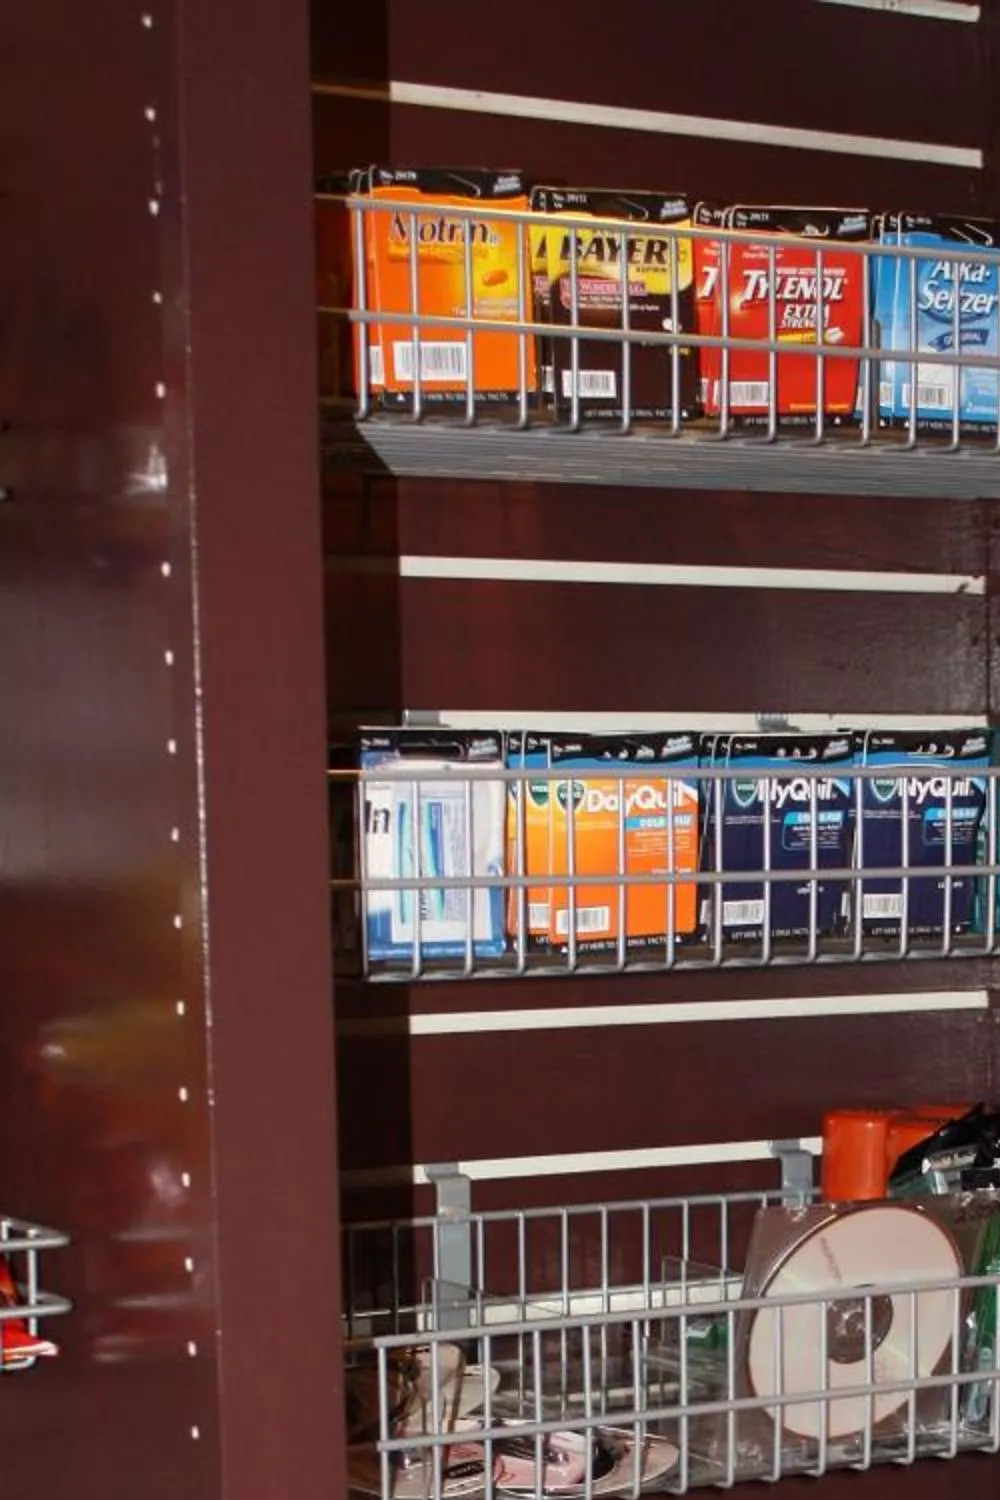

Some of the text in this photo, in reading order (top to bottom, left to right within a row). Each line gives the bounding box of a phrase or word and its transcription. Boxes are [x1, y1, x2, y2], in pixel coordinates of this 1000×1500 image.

[389, 213, 489, 243] Motrn
[560, 234, 668, 264] BAYER
[919, 281, 998, 313] Selzer
[585, 782, 684, 818] DayQuil
[757, 778, 836, 808] NyQuil
[898, 777, 974, 803] NyQuil
